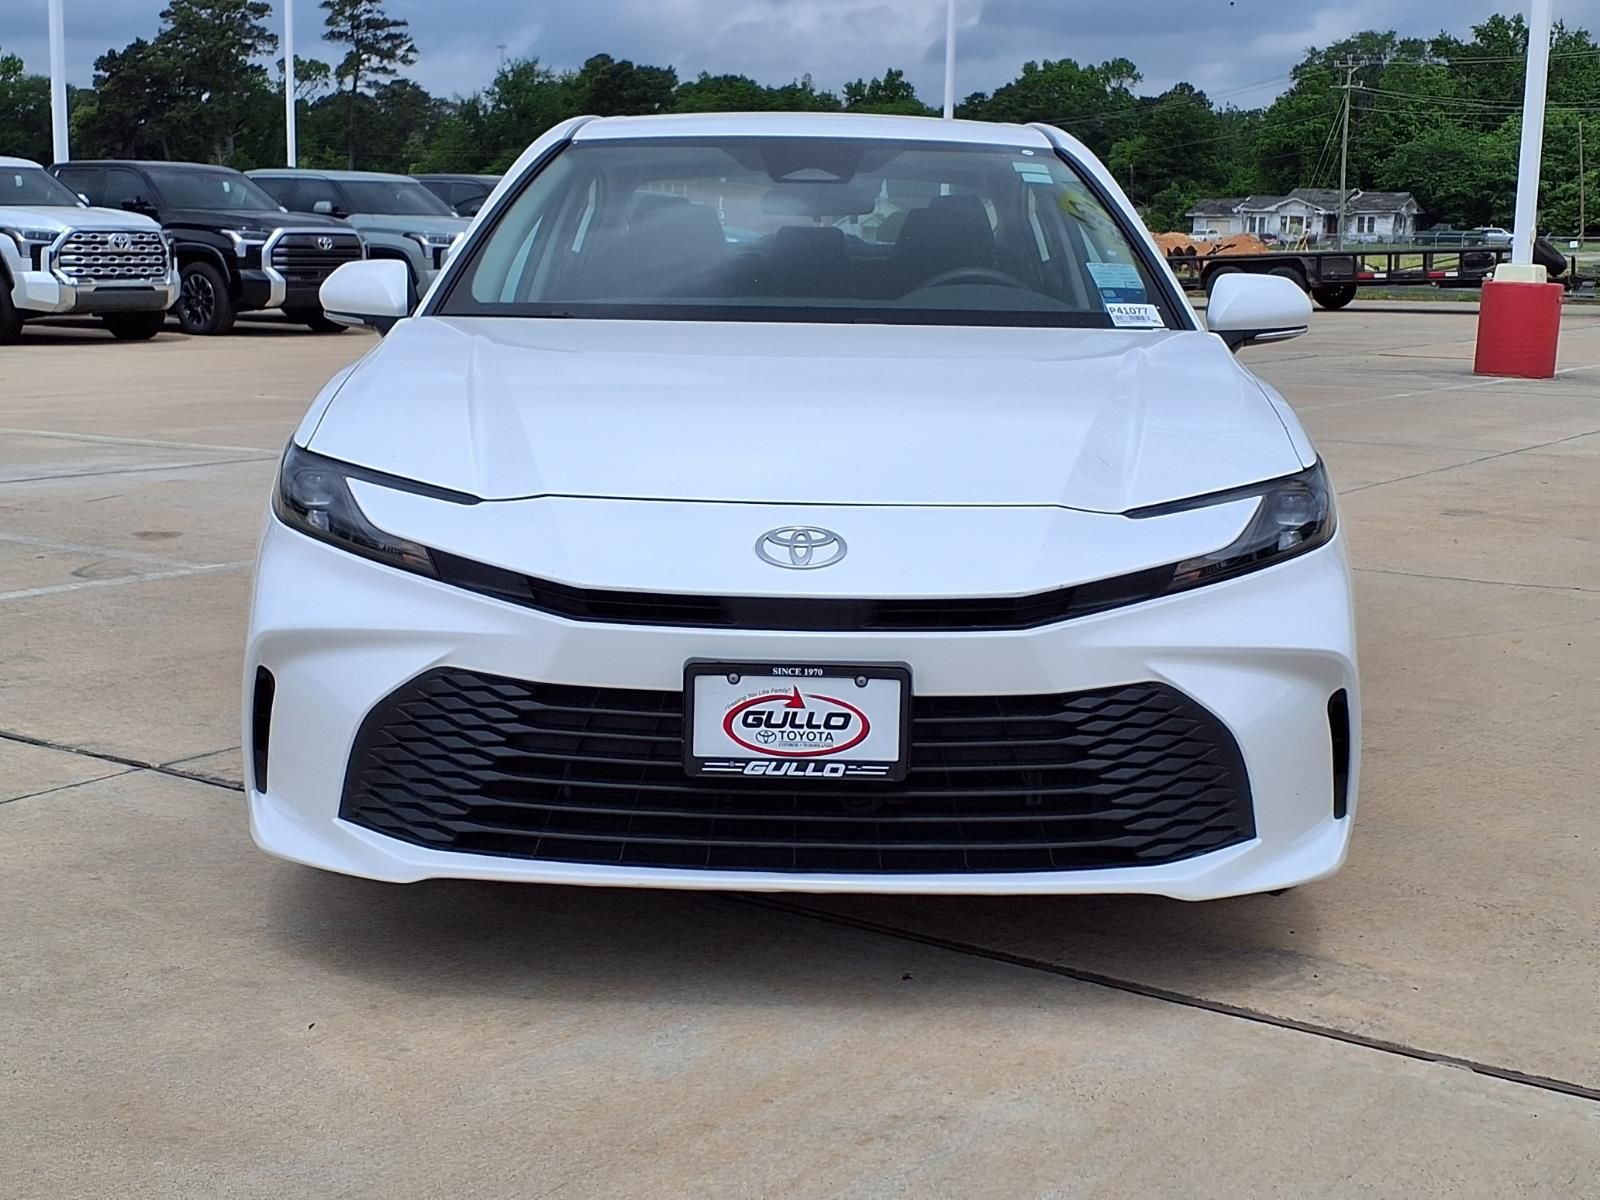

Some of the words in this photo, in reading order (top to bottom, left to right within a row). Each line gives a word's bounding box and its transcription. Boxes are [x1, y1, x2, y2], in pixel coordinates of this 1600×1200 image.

[1109, 306, 1148, 315] P41077
[772, 667, 802, 676] SINCE
[804, 668, 823, 677] 1970
[742, 710, 852, 731] GULLO
[778, 730, 835, 742] TOYOTA
[743, 761, 846, 778] GULLO
